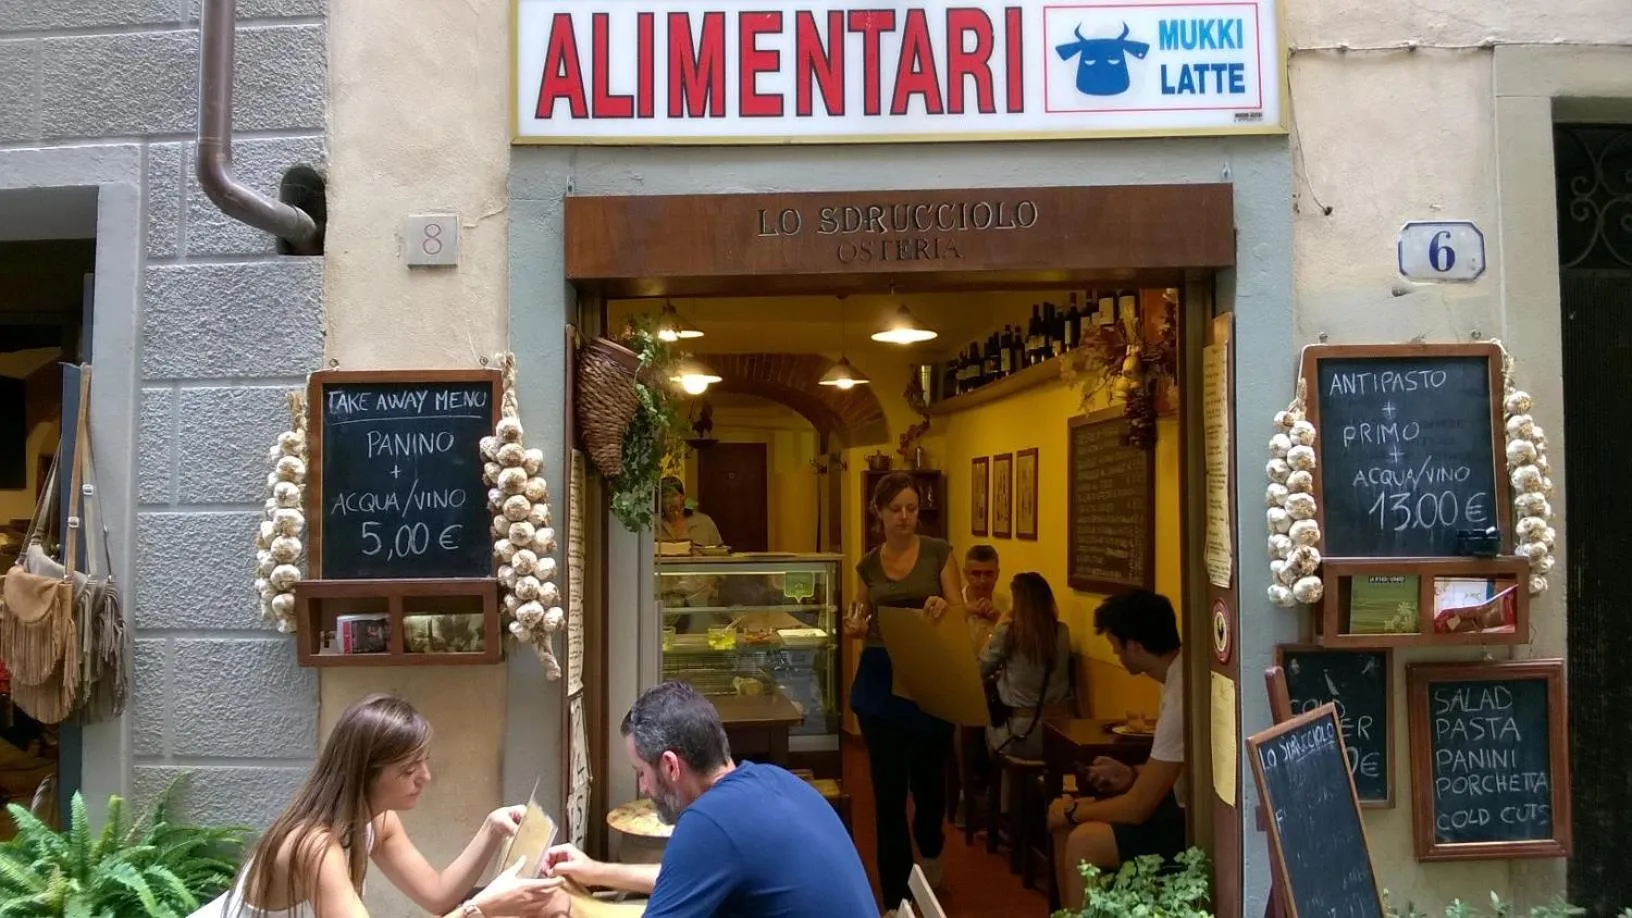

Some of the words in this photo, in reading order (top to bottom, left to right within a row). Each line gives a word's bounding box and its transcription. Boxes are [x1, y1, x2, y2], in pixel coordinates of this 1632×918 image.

[1158, 18, 1244, 51] MUKKI
[534, 6, 1025, 119] ALIMENTARI
[1160, 63, 1246, 95] LATTE
[757, 208, 801, 237] LO
[817, 200, 1039, 235] SDRUCCIOLO
[423, 223, 442, 255] 8
[837, 237, 963, 264] OSTERIA
[1429, 230, 1456, 272] 6
[1329, 370, 1447, 397] ANTIPASTO
[328, 391, 372, 414] TAKE
[377, 390, 428, 413] AWAY
[435, 390, 487, 411] MENU
[367, 431, 455, 458] PANINO
[1343, 421, 1420, 448] PRIMO
[361, 521, 429, 562] 5,00
[439, 523, 464, 550] €
[1434, 685, 1513, 715] SALAD
[1435, 716, 1521, 743] PASTA
[1435, 748, 1517, 774] PANINI
[1435, 772, 1548, 799] PORCHETTA
[1436, 807, 1490, 831] COLD
[1500, 803, 1549, 825] CUTS
